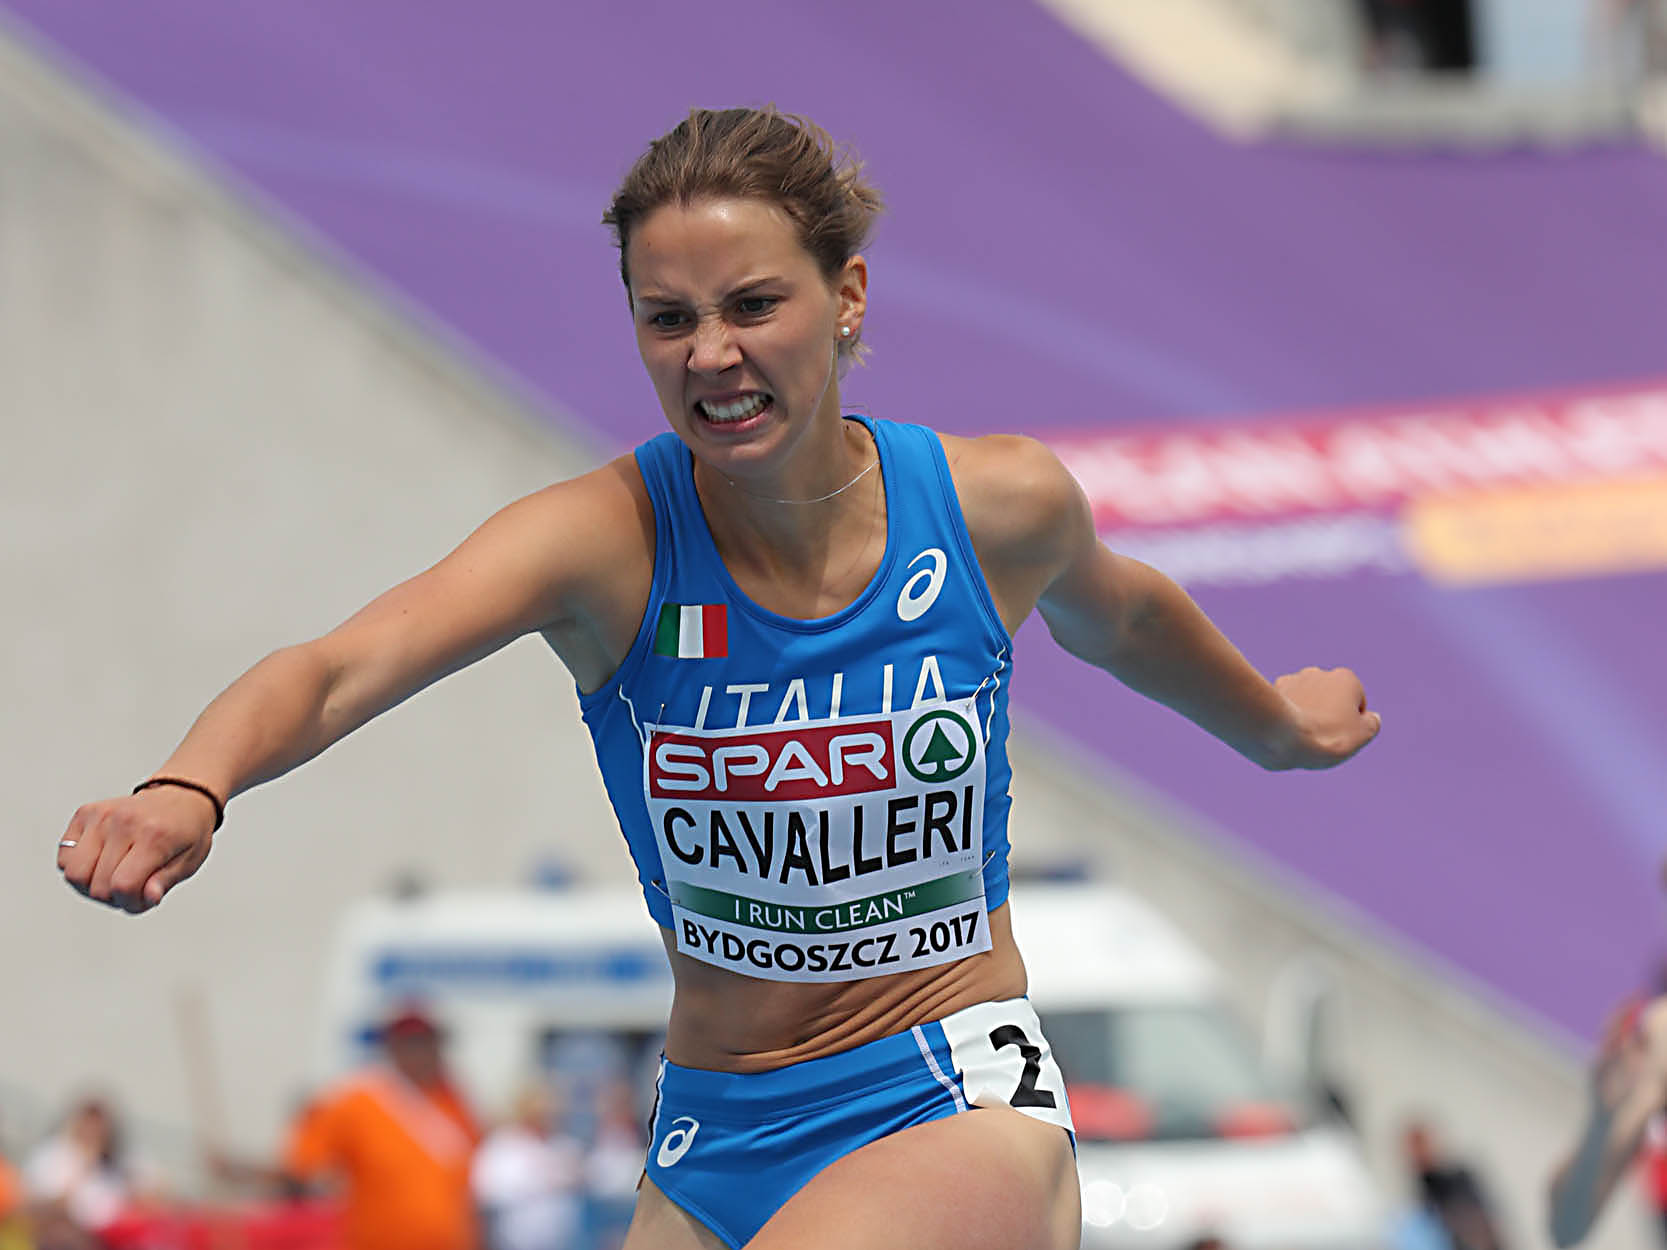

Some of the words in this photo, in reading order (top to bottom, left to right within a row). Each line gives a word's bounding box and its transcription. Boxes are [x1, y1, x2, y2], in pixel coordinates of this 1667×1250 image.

[655, 732, 889, 792] SPAR
[663, 785, 974, 886] CAVALLERI
[682, 918, 900, 973] BYDGOSZCZ
[909, 910, 980, 959] 2017
[735, 899, 741, 920] I
[749, 905, 805, 931] RUN
[988, 1024, 1057, 1109] 2
